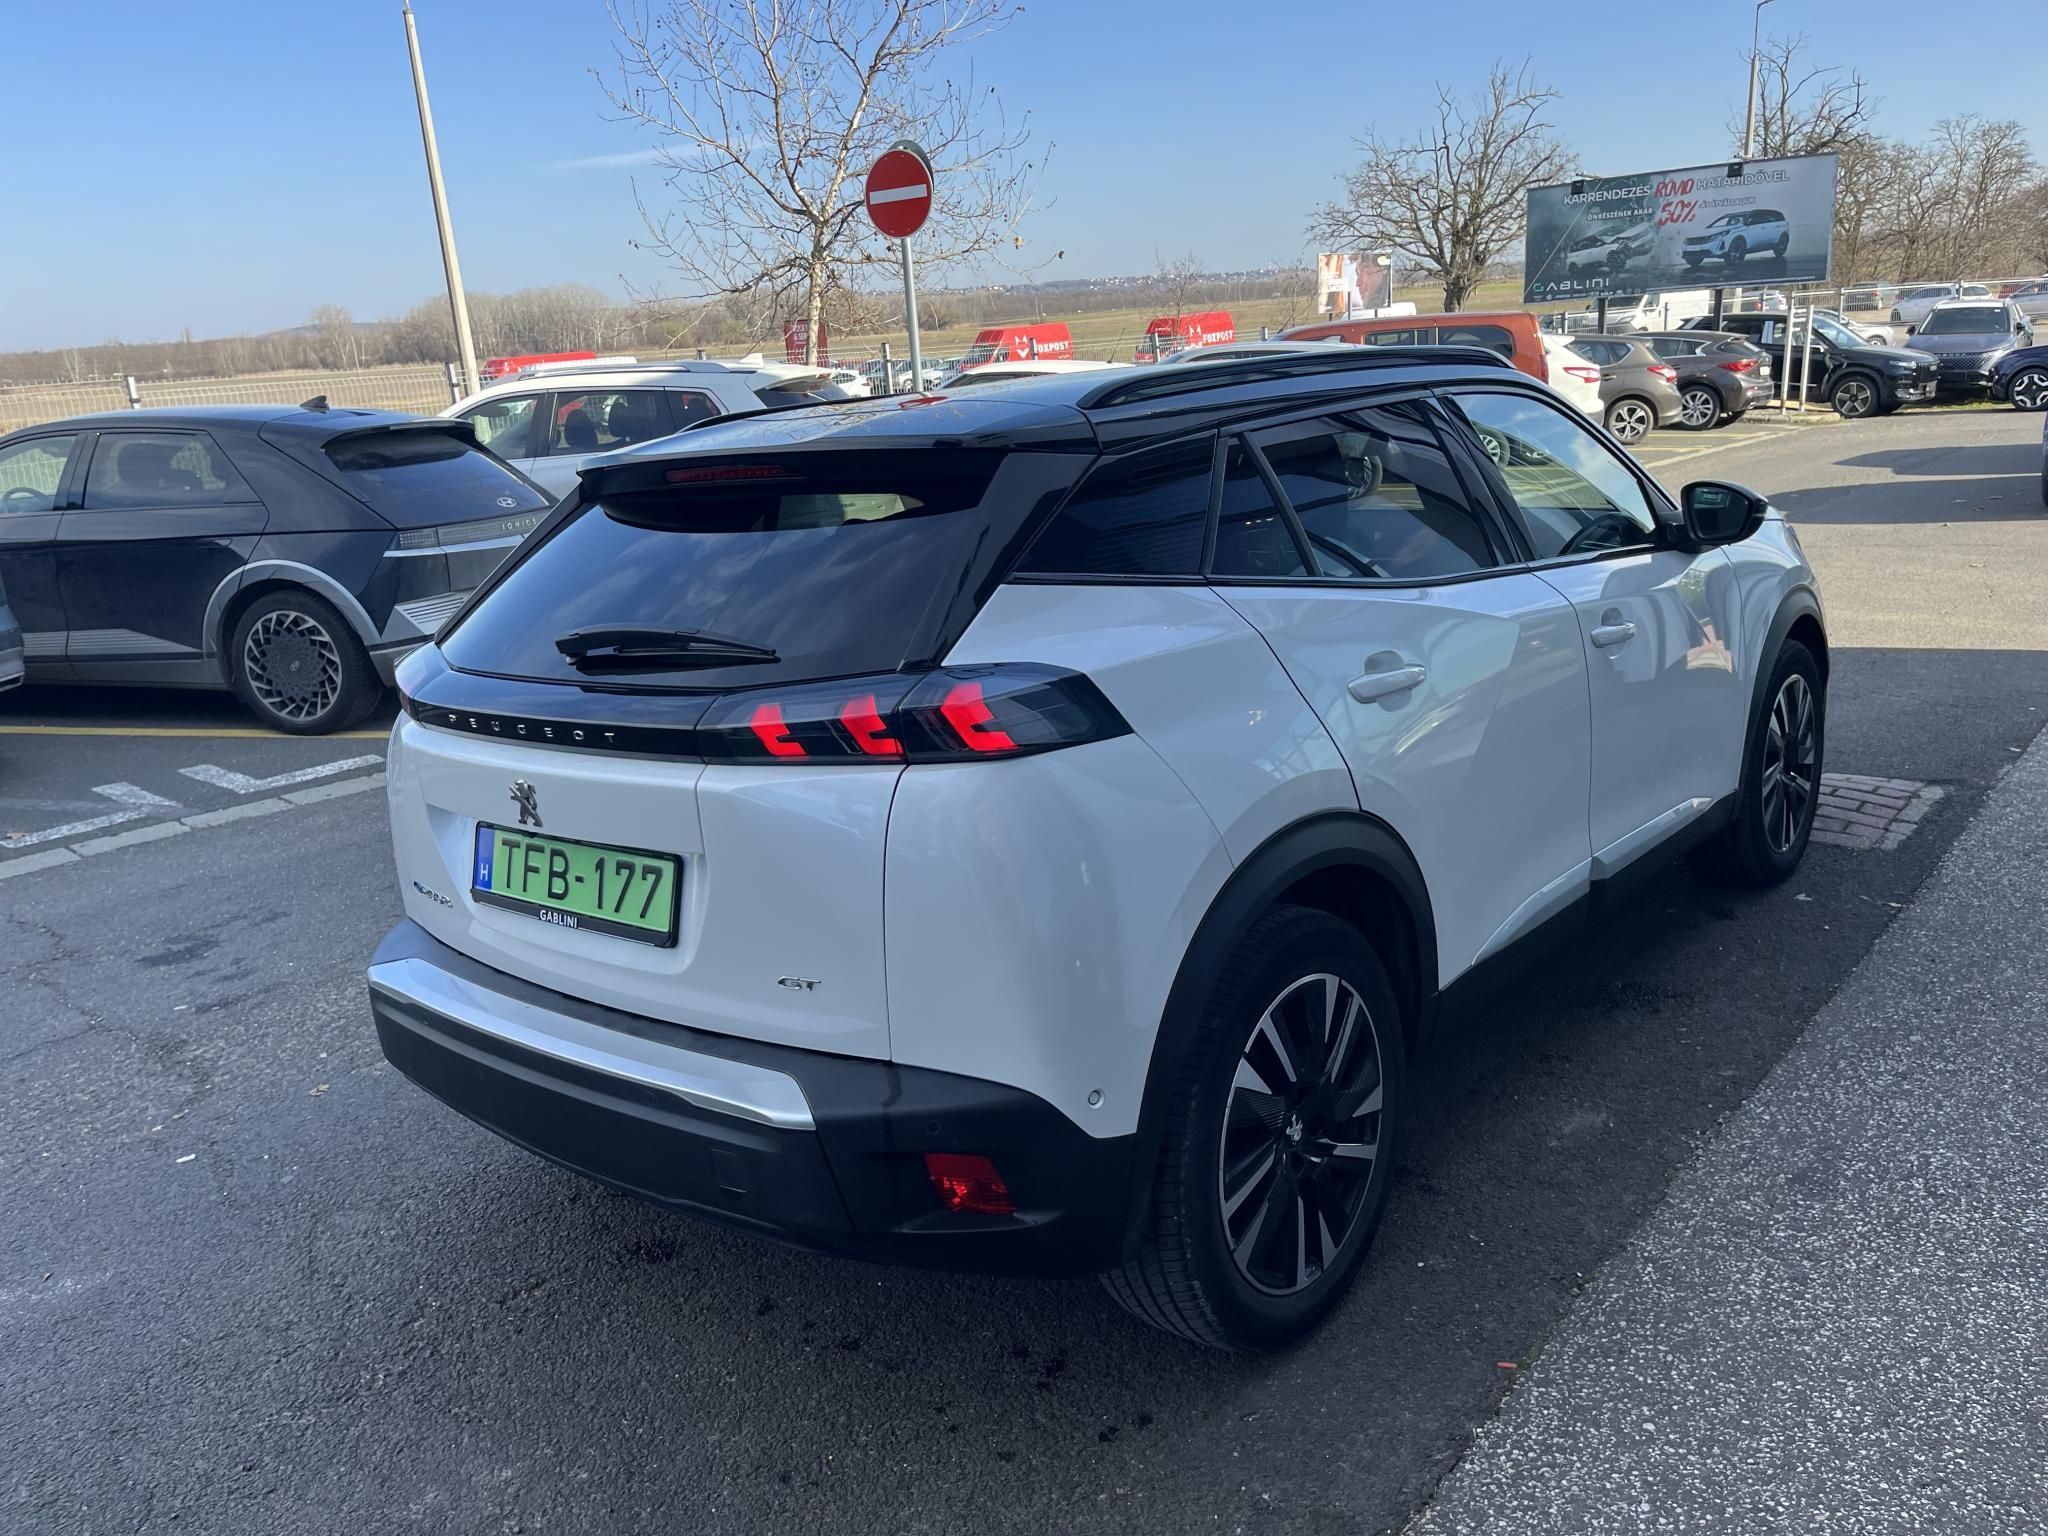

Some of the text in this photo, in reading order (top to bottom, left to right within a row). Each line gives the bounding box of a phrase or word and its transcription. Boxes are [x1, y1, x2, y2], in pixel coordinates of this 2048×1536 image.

[1564, 184, 1651, 205] KARRENDEZÉS
[1657, 200, 1698, 226] 50%
[1533, 278, 1609, 292] GABLINI
[1202, 330, 1234, 344] FOXPOST
[448, 714, 615, 744] PEUGEOT
[479, 863, 489, 882] H
[502, 838, 663, 918] TFB-177
[539, 909, 578, 930] GABLINI
[777, 975, 822, 992] GT
